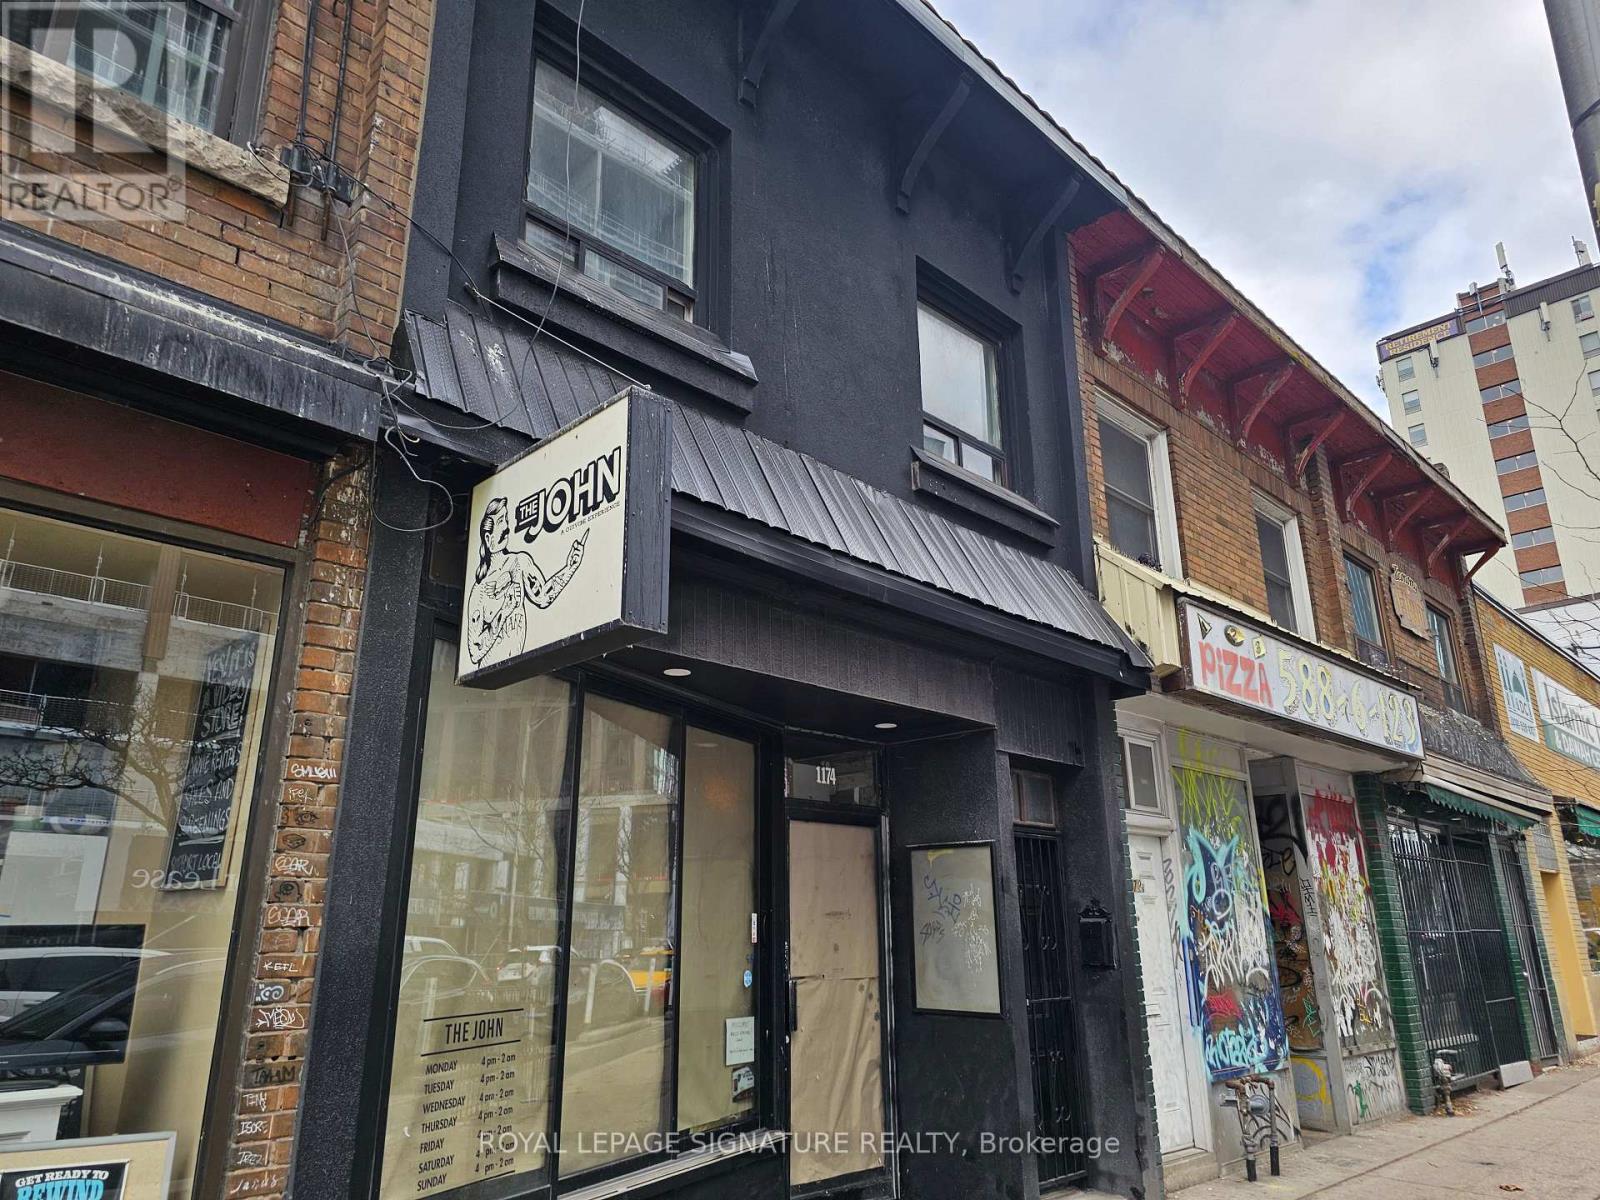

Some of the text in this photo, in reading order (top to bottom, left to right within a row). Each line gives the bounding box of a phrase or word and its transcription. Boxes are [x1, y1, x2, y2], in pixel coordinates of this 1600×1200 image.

[1385, 321, 1450, 350] RETIREMENT
[1390, 331, 1450, 356] RESIDENCE
[519, 446, 621, 539] THE JOHN
[1544, 682, 1595, 743] Islamic
[816, 766, 836, 784] 1174
[215, 778, 234, 801] AND
[445, 1018, 504, 1044] THE JOHN
[425, 1060, 458, 1075] MONDAY
[424, 1079, 455, 1095] TUESDAY
[422, 1095, 466, 1114] WEDNESDAY
[421, 1116, 458, 1134] THURSDAY
[419, 1137, 445, 1154] FRIDAY
[418, 1154, 455, 1174] SATURDAY
[15, 1169, 109, 1188] GET READY TO
[417, 1172, 447, 1192] SUNDAY
